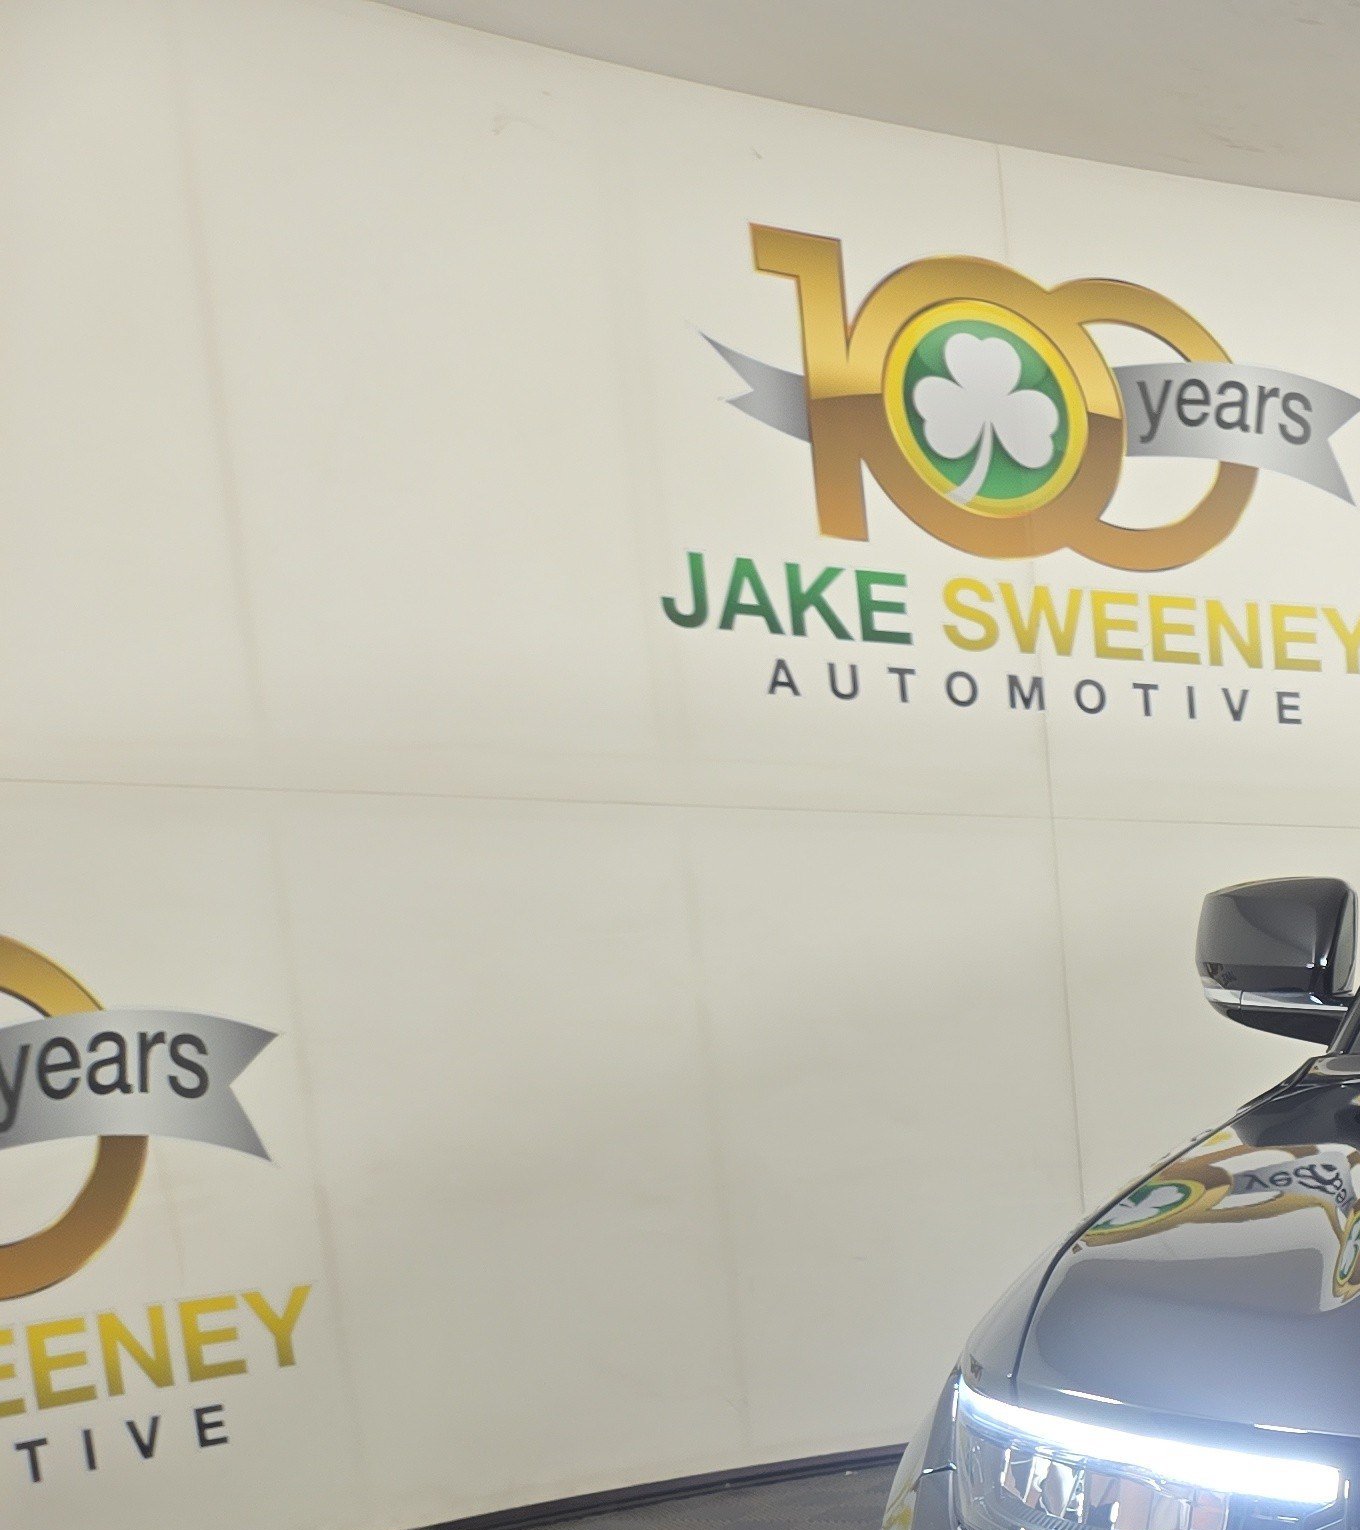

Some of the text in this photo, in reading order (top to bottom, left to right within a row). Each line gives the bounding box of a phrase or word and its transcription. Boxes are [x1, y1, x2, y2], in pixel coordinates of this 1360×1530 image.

[1138, 376, 1313, 446] years
[661, 551, 914, 646] JAKE
[768, 657, 1304, 726] AUTOMOTIVE
